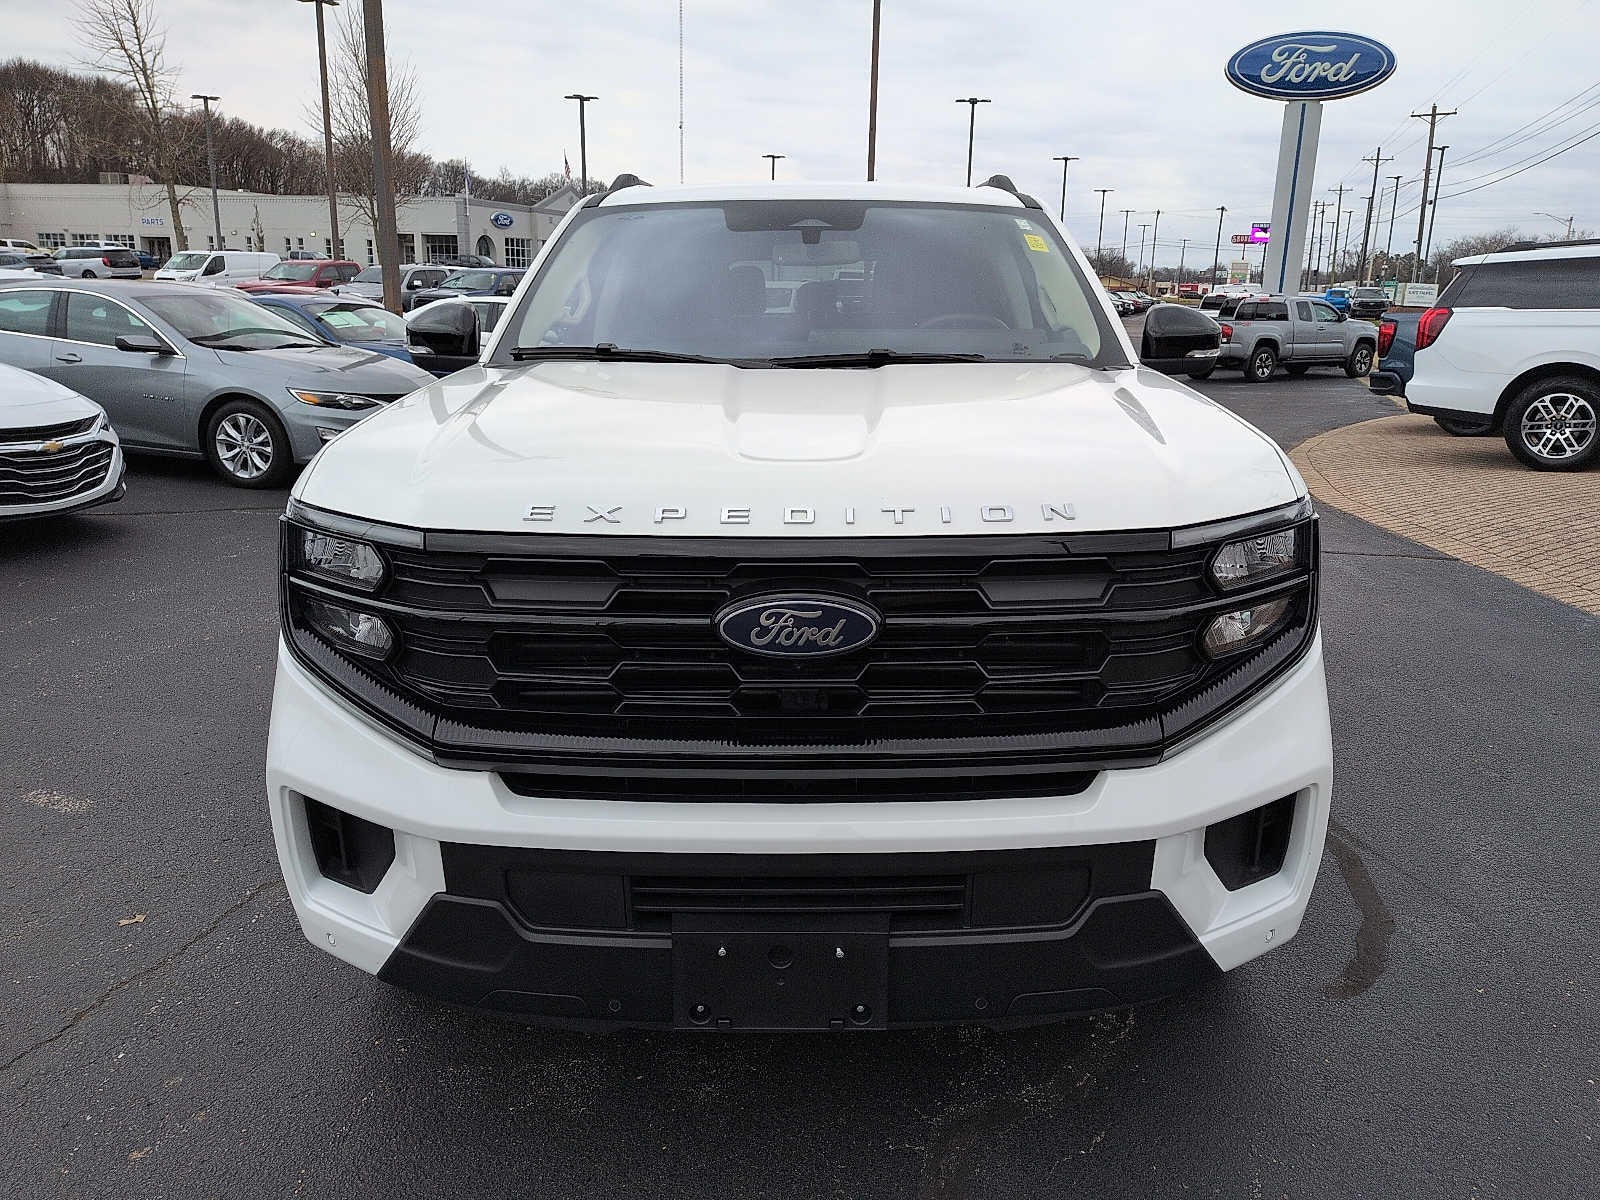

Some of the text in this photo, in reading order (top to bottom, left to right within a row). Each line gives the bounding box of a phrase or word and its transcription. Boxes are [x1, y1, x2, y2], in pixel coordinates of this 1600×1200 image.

[1260, 43, 1361, 84] Ford
[141, 218, 164, 226] PARTS
[523, 502, 1076, 526] EXPEDITION
[749, 607, 847, 649] Ford
